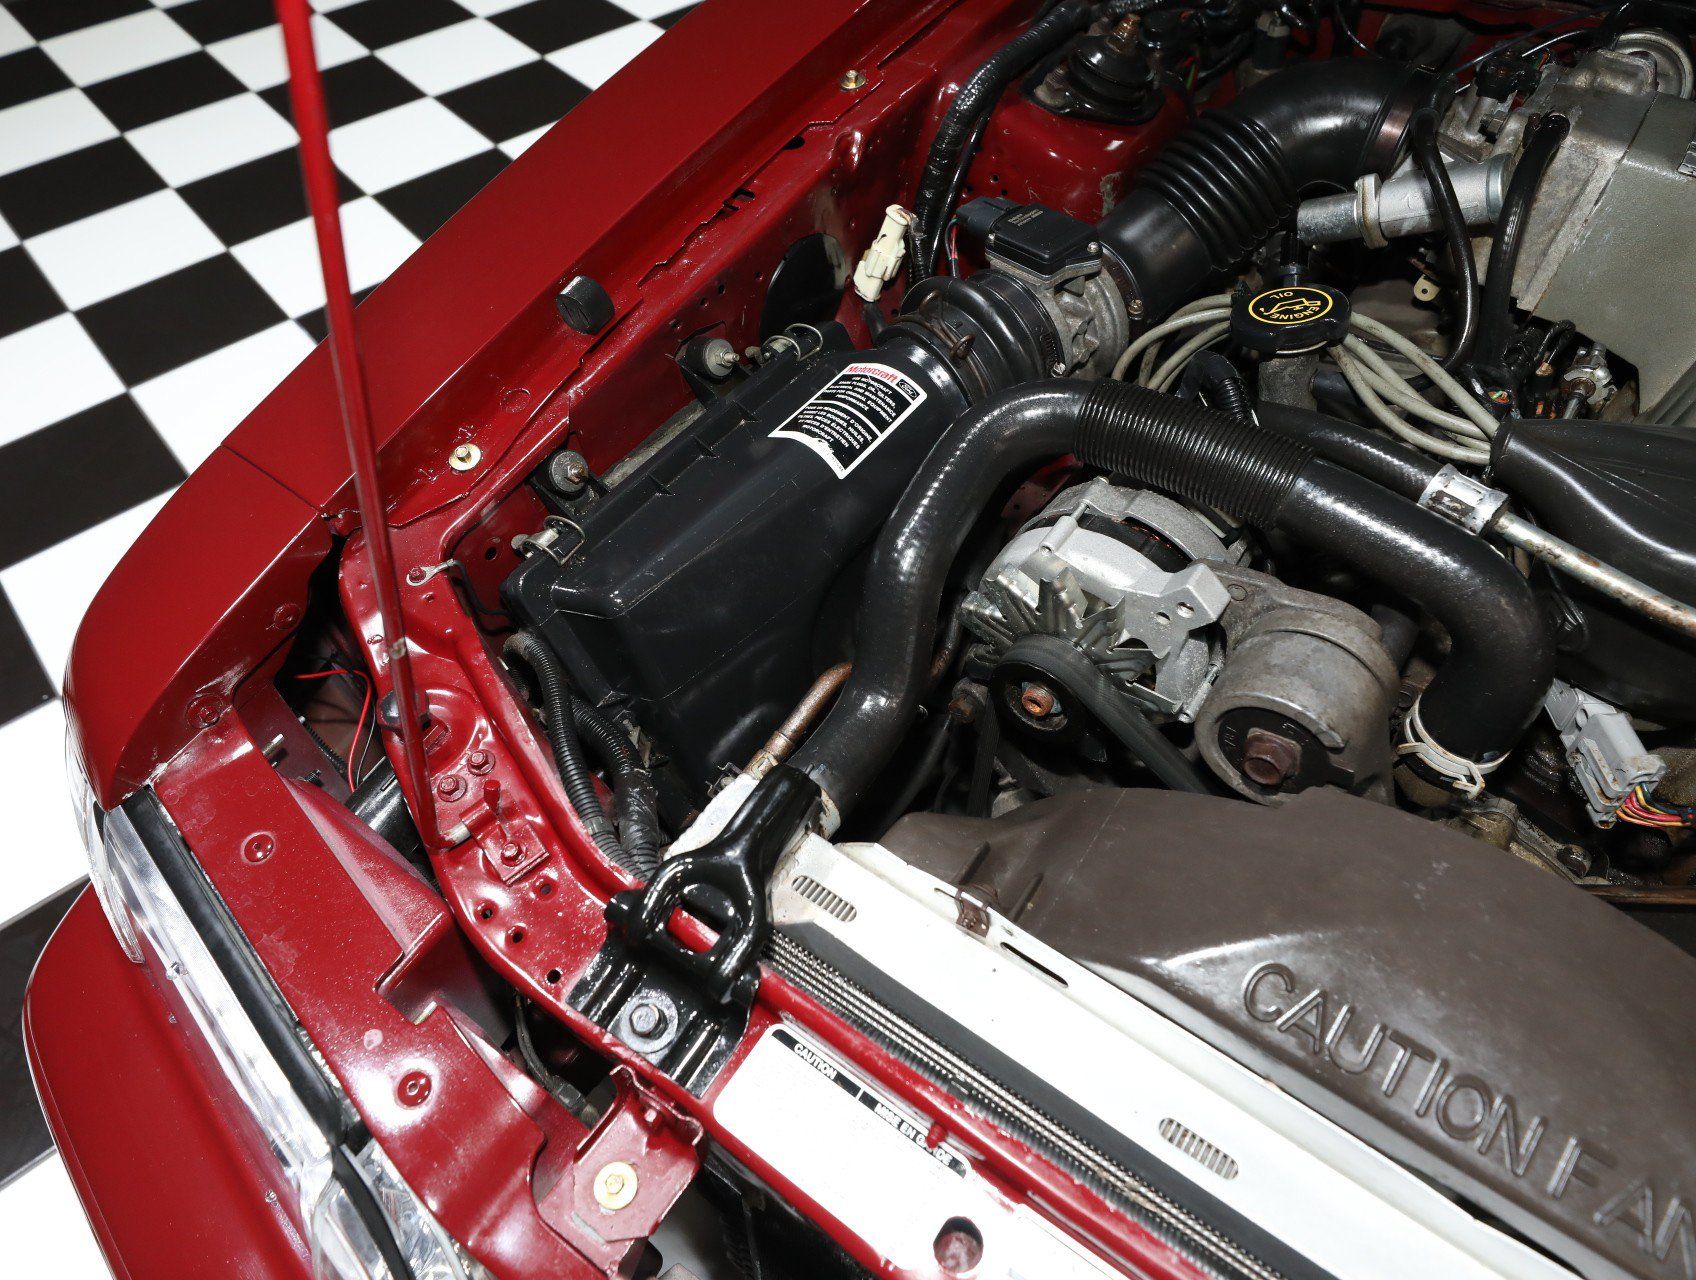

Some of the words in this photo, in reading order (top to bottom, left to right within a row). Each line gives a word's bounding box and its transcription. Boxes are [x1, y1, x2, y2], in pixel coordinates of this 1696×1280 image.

[1270, 291, 1294, 299] OIL
[1270, 306, 1320, 320] ENGINE
[845, 365, 898, 383] Motorcraft
[864, 391, 897, 418] MAINTENANCE
[867, 400, 893, 423] EQUIPMENT
[802, 424, 834, 442] MOTORCRAFT
[793, 1043, 837, 1080] CAUTION
[874, 1102, 902, 1128] MISE
[901, 1123, 917, 1140] EN
[1242, 961, 1549, 1178] CAUTION
[1545, 1134, 1696, 1280] FAN
